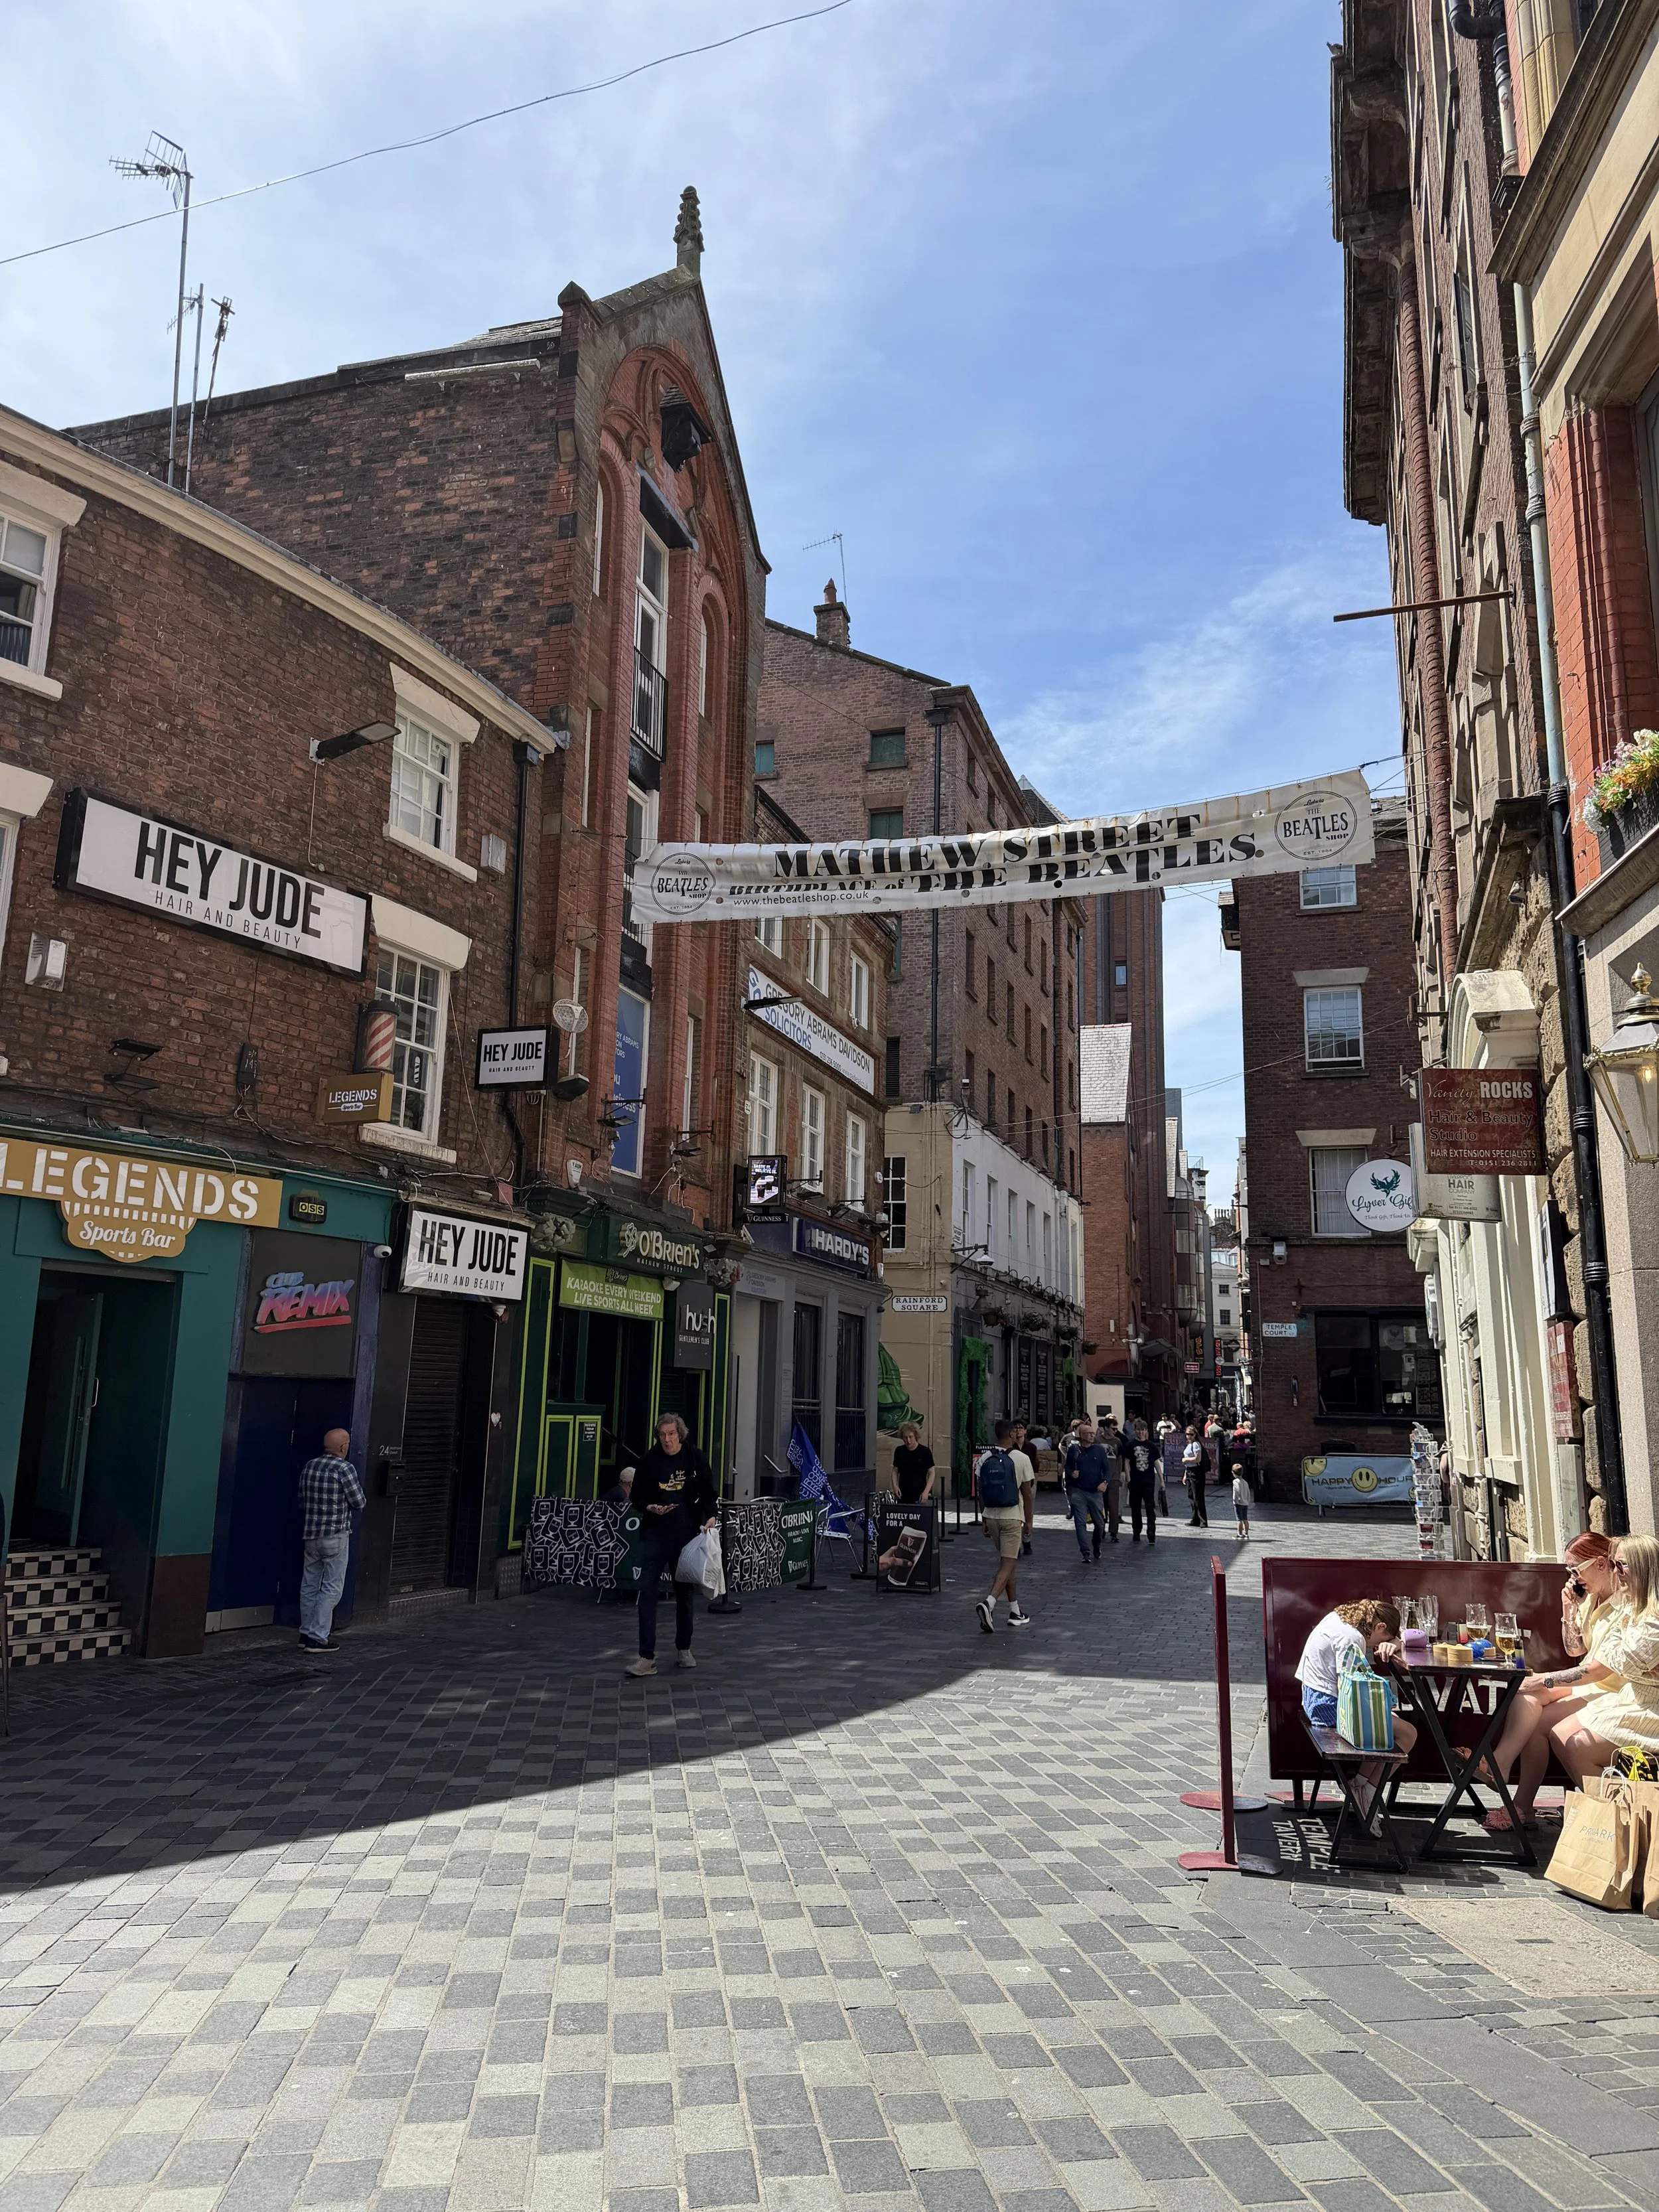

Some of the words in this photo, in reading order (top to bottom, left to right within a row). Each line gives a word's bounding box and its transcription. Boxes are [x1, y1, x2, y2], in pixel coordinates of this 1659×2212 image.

[1283, 812, 1348, 840] BEATLES
[774, 838, 987, 879] MATHEW
[1003, 814, 1201, 863] STREET
[134, 821, 222, 901] HEY
[229, 857, 326, 939] JUDE
[657, 877, 709, 897] BEATLES
[910, 867, 1007, 893] THE
[733, 890, 869, 906] www.thebeatleshop.co.uk
[155, 890, 193, 915] HAIR
[203, 907, 234, 928] AND
[243, 919, 301, 949] BEAUTY
[764, 1005, 812, 1051] SOLICITORS
[483, 1043, 509, 1063] HEY
[511, 1041, 543, 1061] JUDE
[807, 1015, 837, 1050] ABRAMS
[838, 1038, 871, 1074] DAVIDSON
[328, 1088, 378, 1104] LEGENDS
[1426, 1079, 1475, 1106] Vanity
[1479, 1081, 1533, 1099] ROCKS
[1428, 1110, 1461, 1124] Hair
[1465, 1110, 1477, 1124] &
[1481, 1110, 1534, 1126] Beauty
[1429, 1127, 1477, 1141] Studio
[1430, 1149, 1448, 1158] HAIR
[1449, 1149, 1490, 1158] EXTENSION
[1492, 1149, 1536, 1159] SPECIALISTS
[0, 1142, 259, 1220] LEGENDS
[1448, 1179, 1475, 1190] HAIR
[299, 1202, 325, 1215] OSS
[80, 1220, 136, 1246] Sports
[141, 1227, 176, 1251] Bar
[418, 1219, 466, 1268] HEY
[468, 1228, 519, 1276] JUDE
[814, 1228, 870, 1266] HARDY'S
[664, 1263, 683, 1273] STREET
[427, 1272, 449, 1284] HAIR
[453, 1275, 470, 1288] AND
[474, 1278, 505, 1291] BEAUTY
[566, 1277, 604, 1294] KARAOKE
[605, 1284, 629, 1299] EVERY
[628, 1288, 662, 1304] WEEKEND
[256, 1279, 355, 1324] REMIX
[573, 1291, 593, 1306] LIVE
[593, 1294, 621, 1310] SPORTS
[620, 1300, 635, 1313] ALL
[634, 1302, 654, 1315] WEEK
[685, 1304, 717, 1334] hush
[679, 1334, 700, 1344] GENTLEMEN'S
[379, 1445, 390, 1455] 24
[1311, 1477, 1352, 1486] HAPPY
[1272, 1820, 1303, 1862] TAVERN
